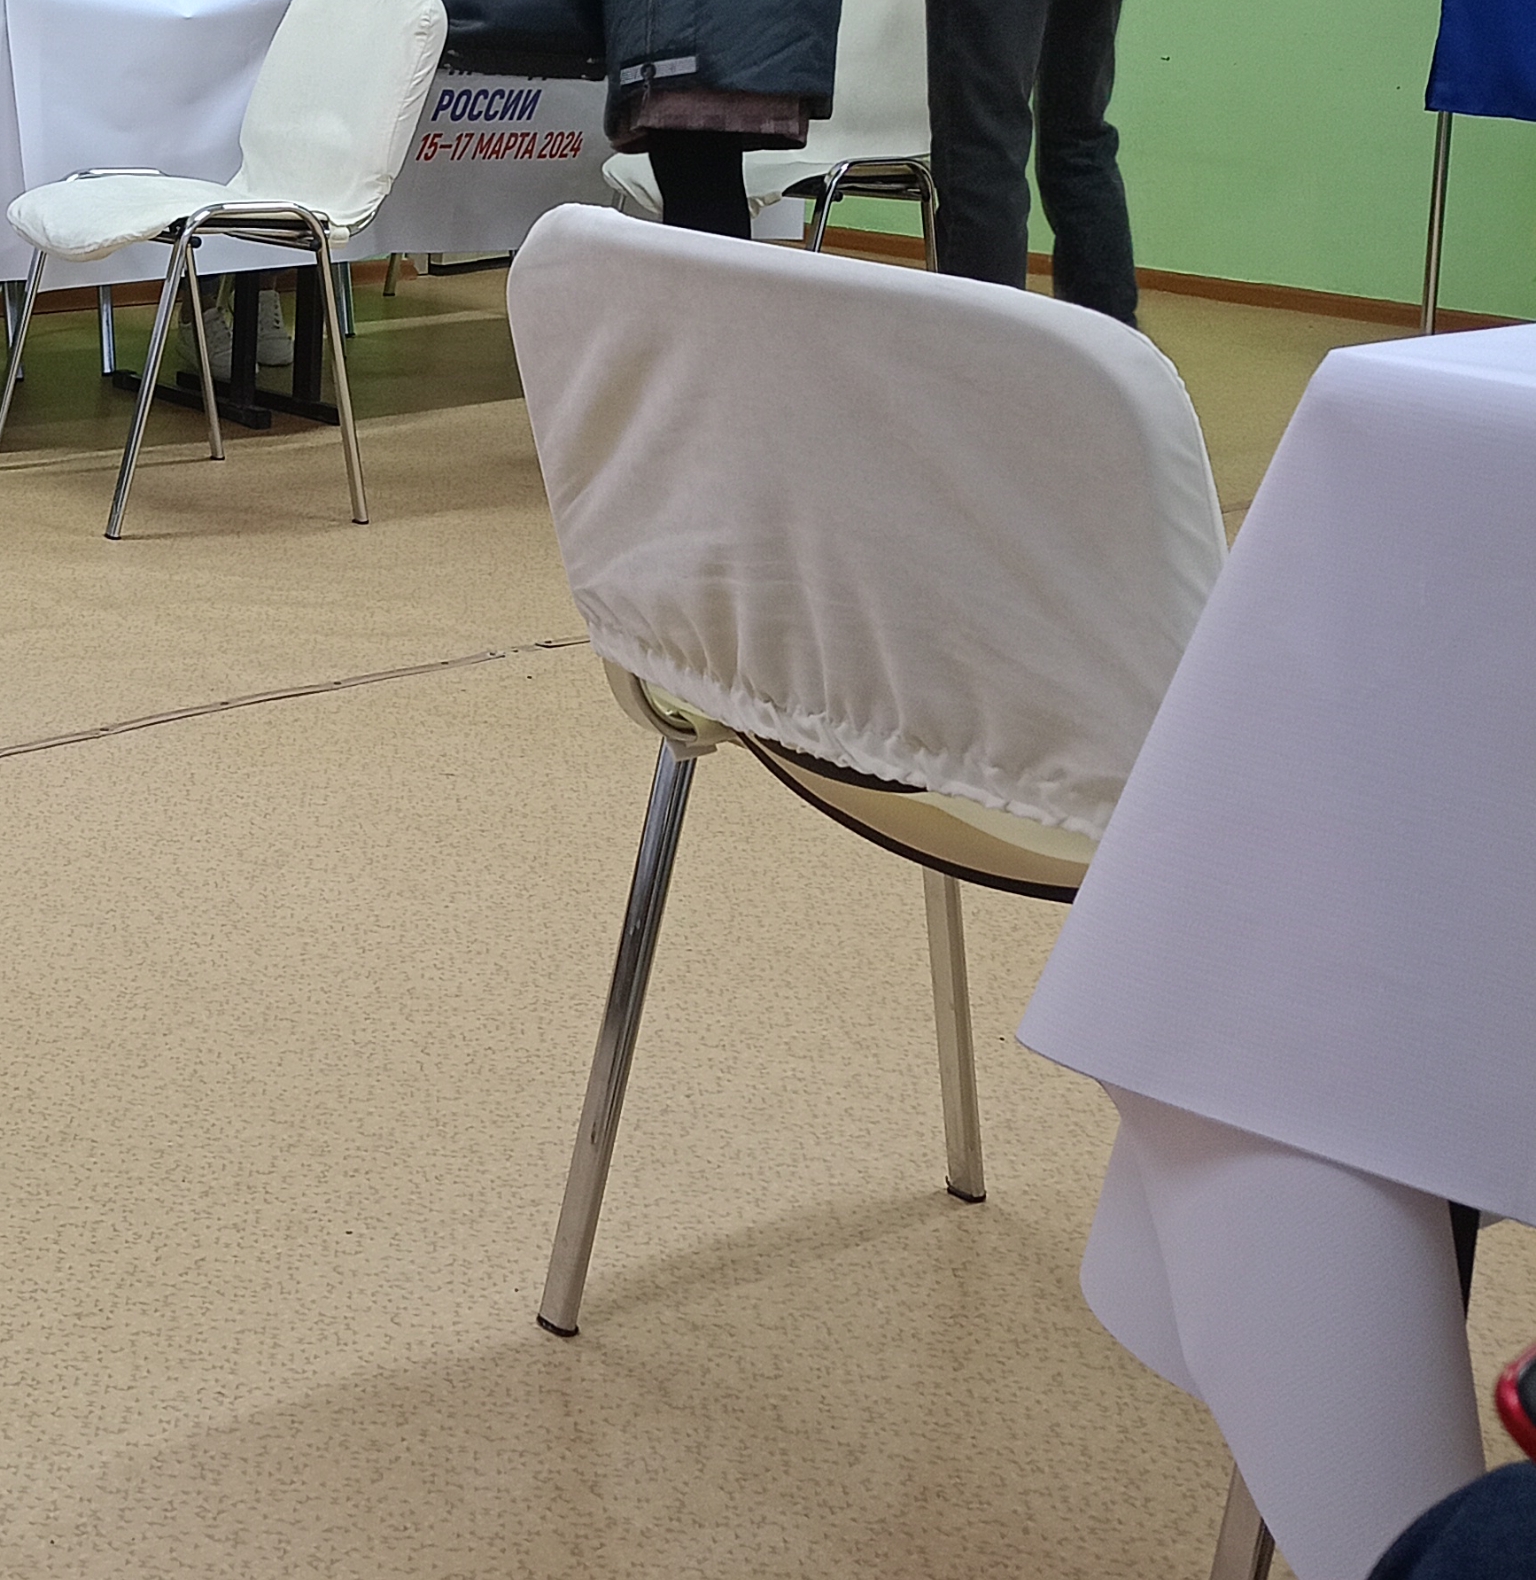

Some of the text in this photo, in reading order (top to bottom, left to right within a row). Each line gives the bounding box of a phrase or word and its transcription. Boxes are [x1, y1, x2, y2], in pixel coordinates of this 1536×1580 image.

[431, 89, 542, 121] РОССИИ
[471, 131, 539, 160] МАРТА
[536, 131, 583, 159] 2024
